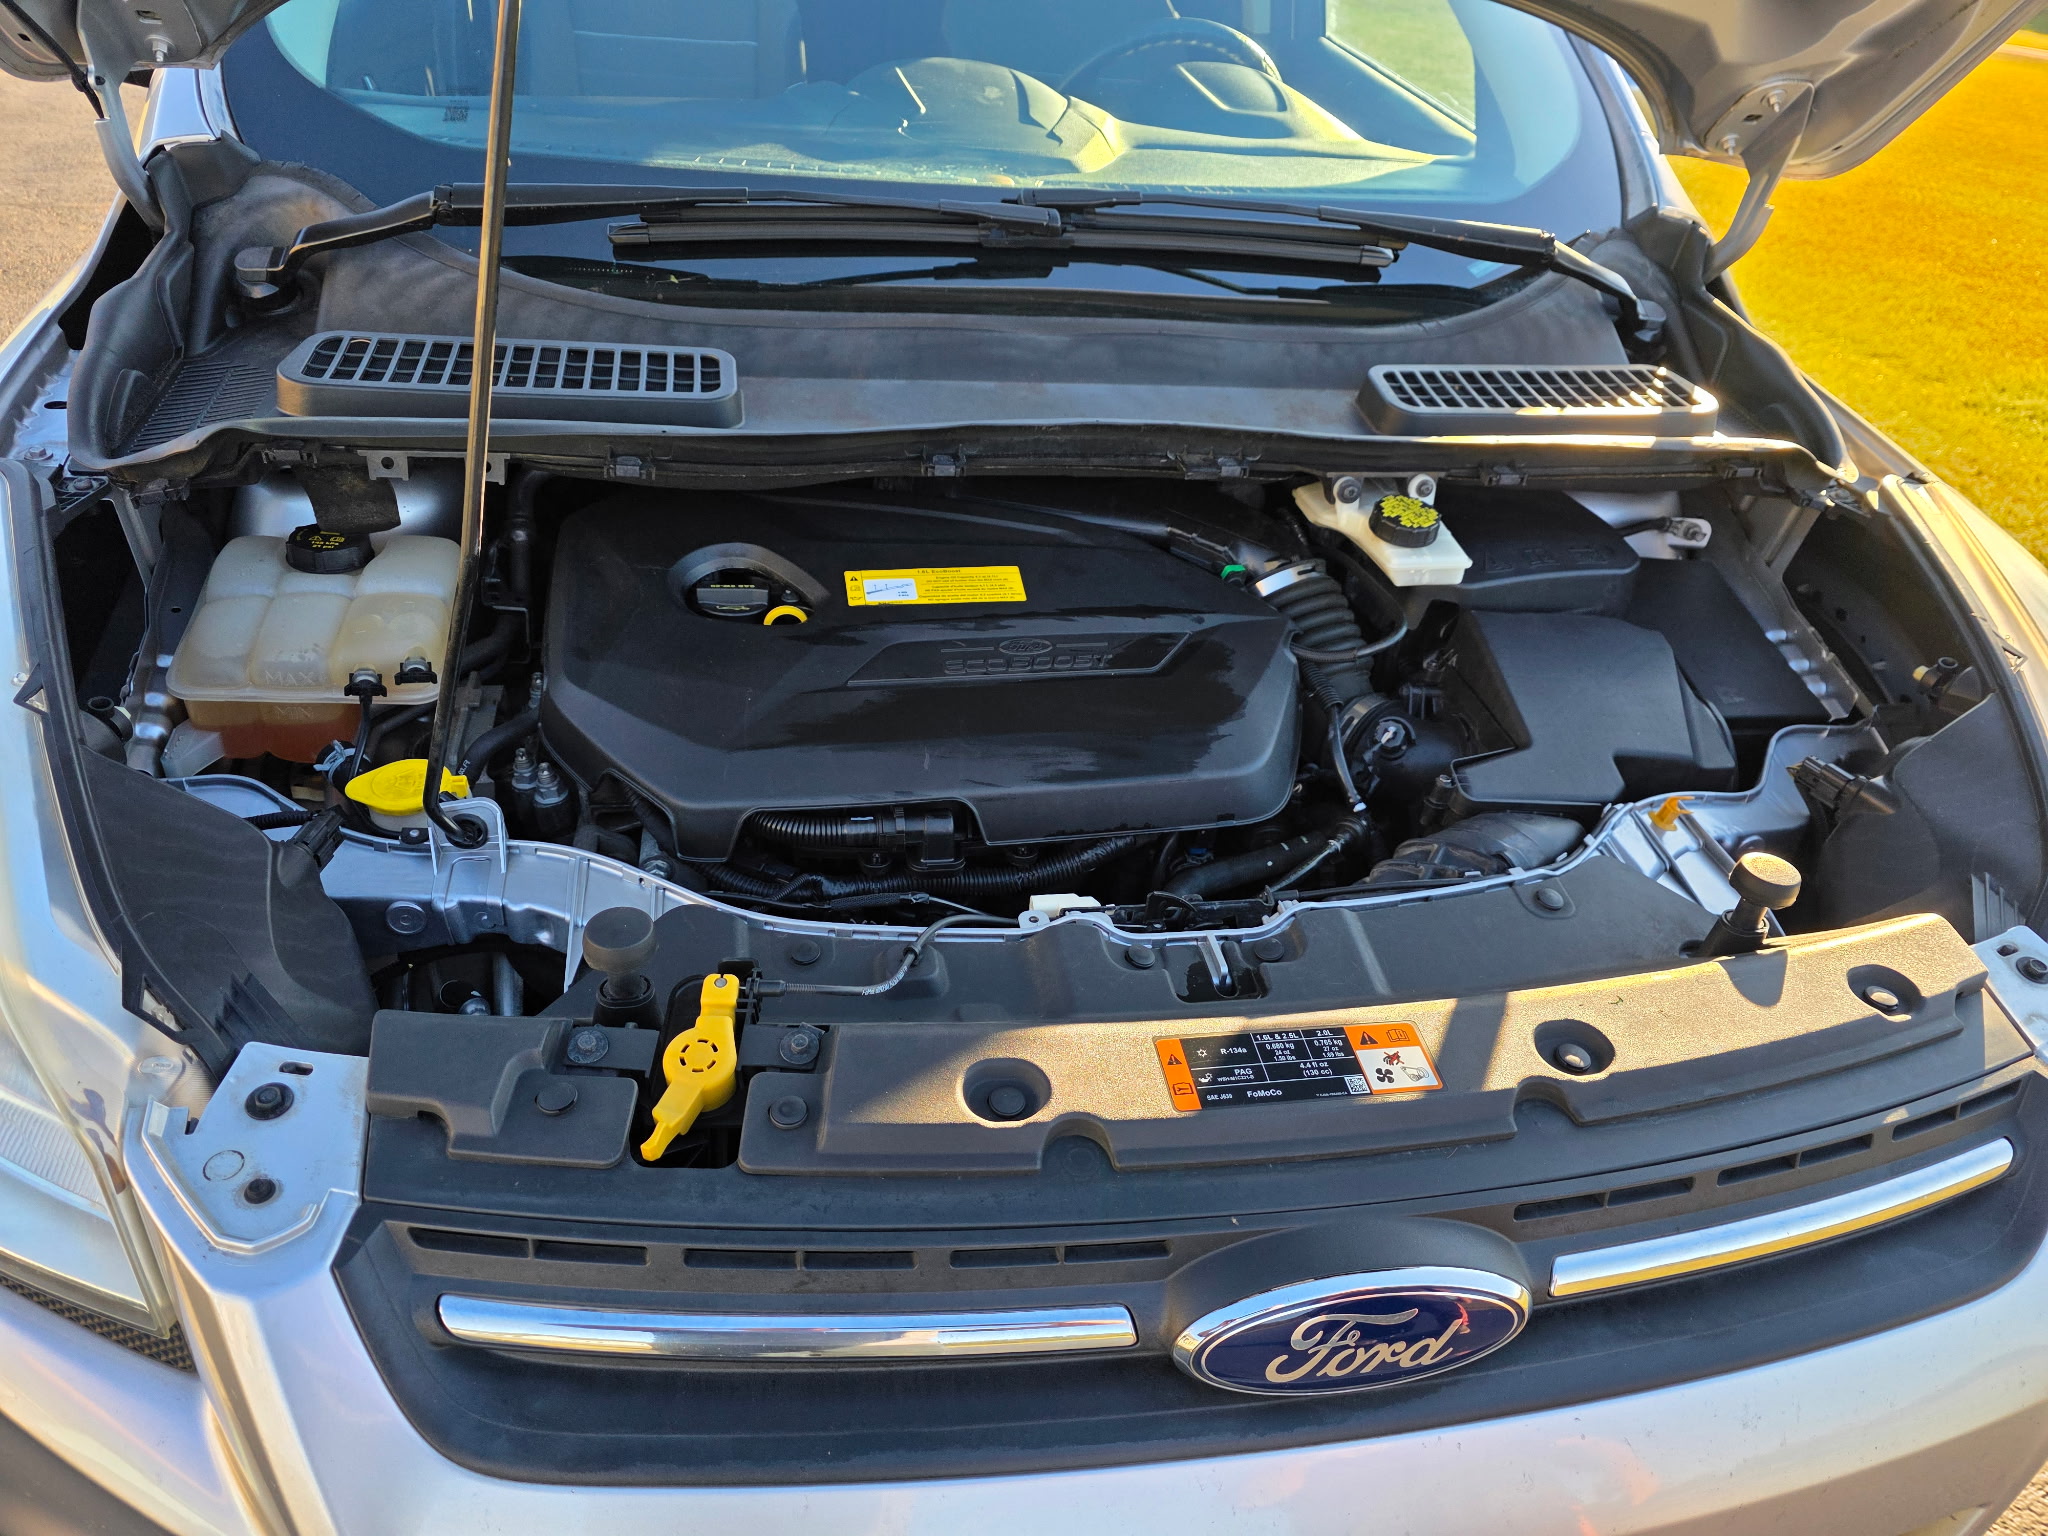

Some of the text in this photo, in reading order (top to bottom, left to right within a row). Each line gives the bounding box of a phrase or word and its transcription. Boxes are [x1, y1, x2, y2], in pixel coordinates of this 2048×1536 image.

[264, 669, 316, 688] MAX
[1315, 1029, 1333, 1037] 2.0L
[1285, 1042, 1295, 1050] kg
[1333, 1038, 1343, 1047] kg
[1220, 1046, 1248, 1055] R-134a
[1234, 1067, 1253, 1076] PAG
[1320, 1068, 1333, 1076] cc)
[1246, 1088, 1283, 1098] FoMoCo
[1265, 1307, 1463, 1383] Ford
